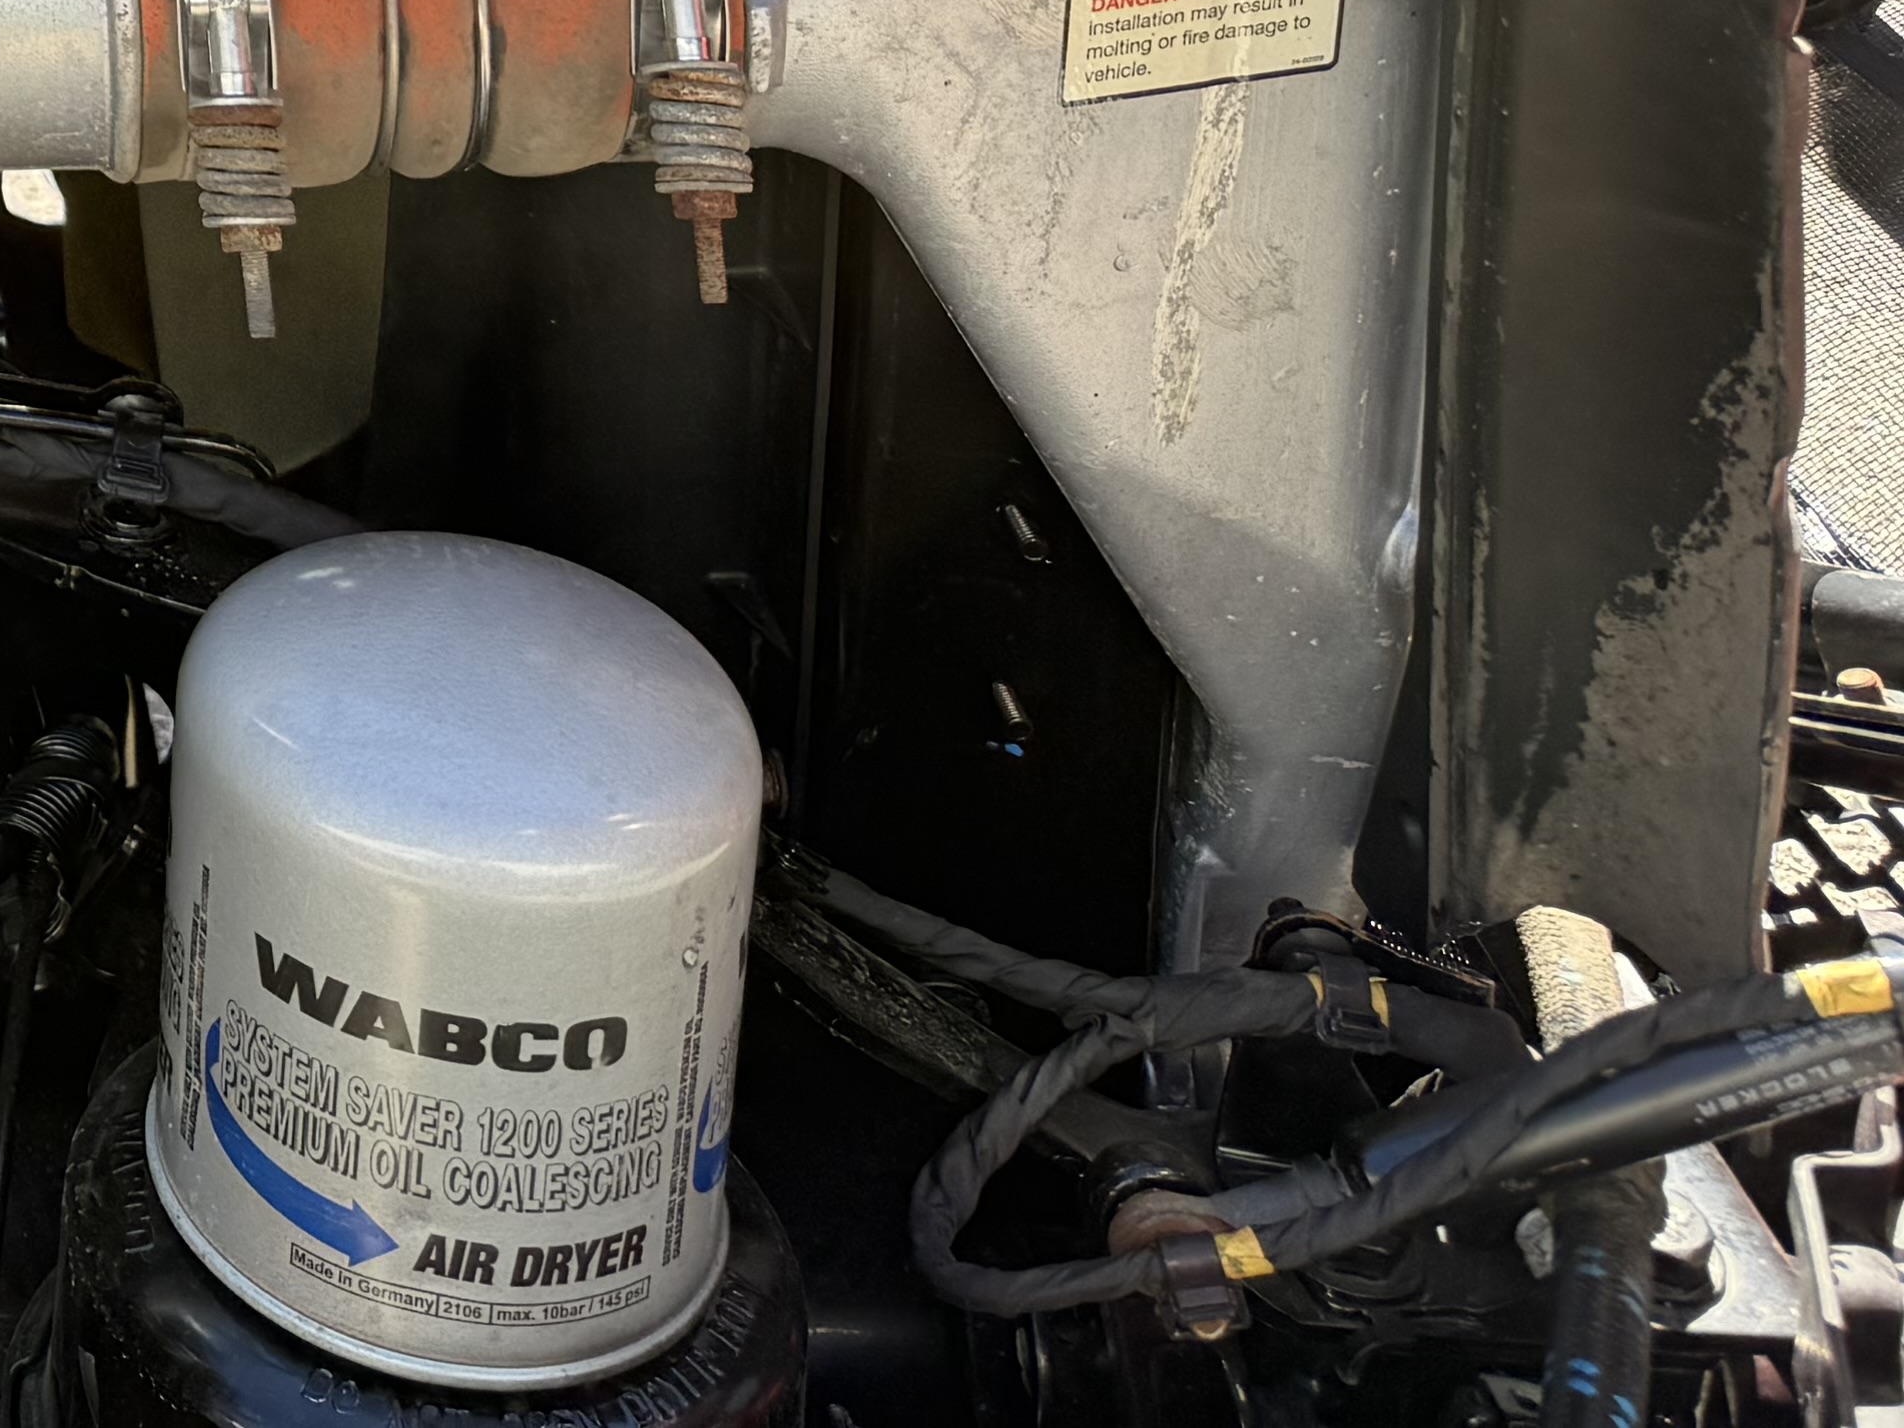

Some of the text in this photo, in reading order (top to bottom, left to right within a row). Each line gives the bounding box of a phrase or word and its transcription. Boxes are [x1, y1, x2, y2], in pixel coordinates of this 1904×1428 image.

[1089, 10, 1185, 36] installation
[1190, 3, 1227, 25] may
[1158, 34, 1177, 50] or
[1182, 29, 1210, 46] fire
[1214, 18, 1288, 43] damage
[1293, 14, 1311, 31] to
[1084, 62, 1152, 83] vehicle.
[254, 932, 628, 1074] WABCO
[224, 999, 342, 1119] SYSTEM
[345, 1079, 464, 1150] SAVER
[477, 1106, 564, 1155] 1200
[569, 1084, 672, 1158] SERIES
[220, 1052, 360, 1179] PREMIUM
[370, 1145, 431, 1200] OIL
[448, 1146, 663, 1214] COALESCING
[293, 1248, 435, 1316] Made in Germany
[413, 1224, 648, 1288] AIR DRYER
[441, 1302, 483, 1319] 2106
[496, 1306, 536, 1323] max.
[541, 1302, 584, 1321] 10bar
[598, 1290, 622, 1308] 145
[624, 1283, 648, 1303] psi
